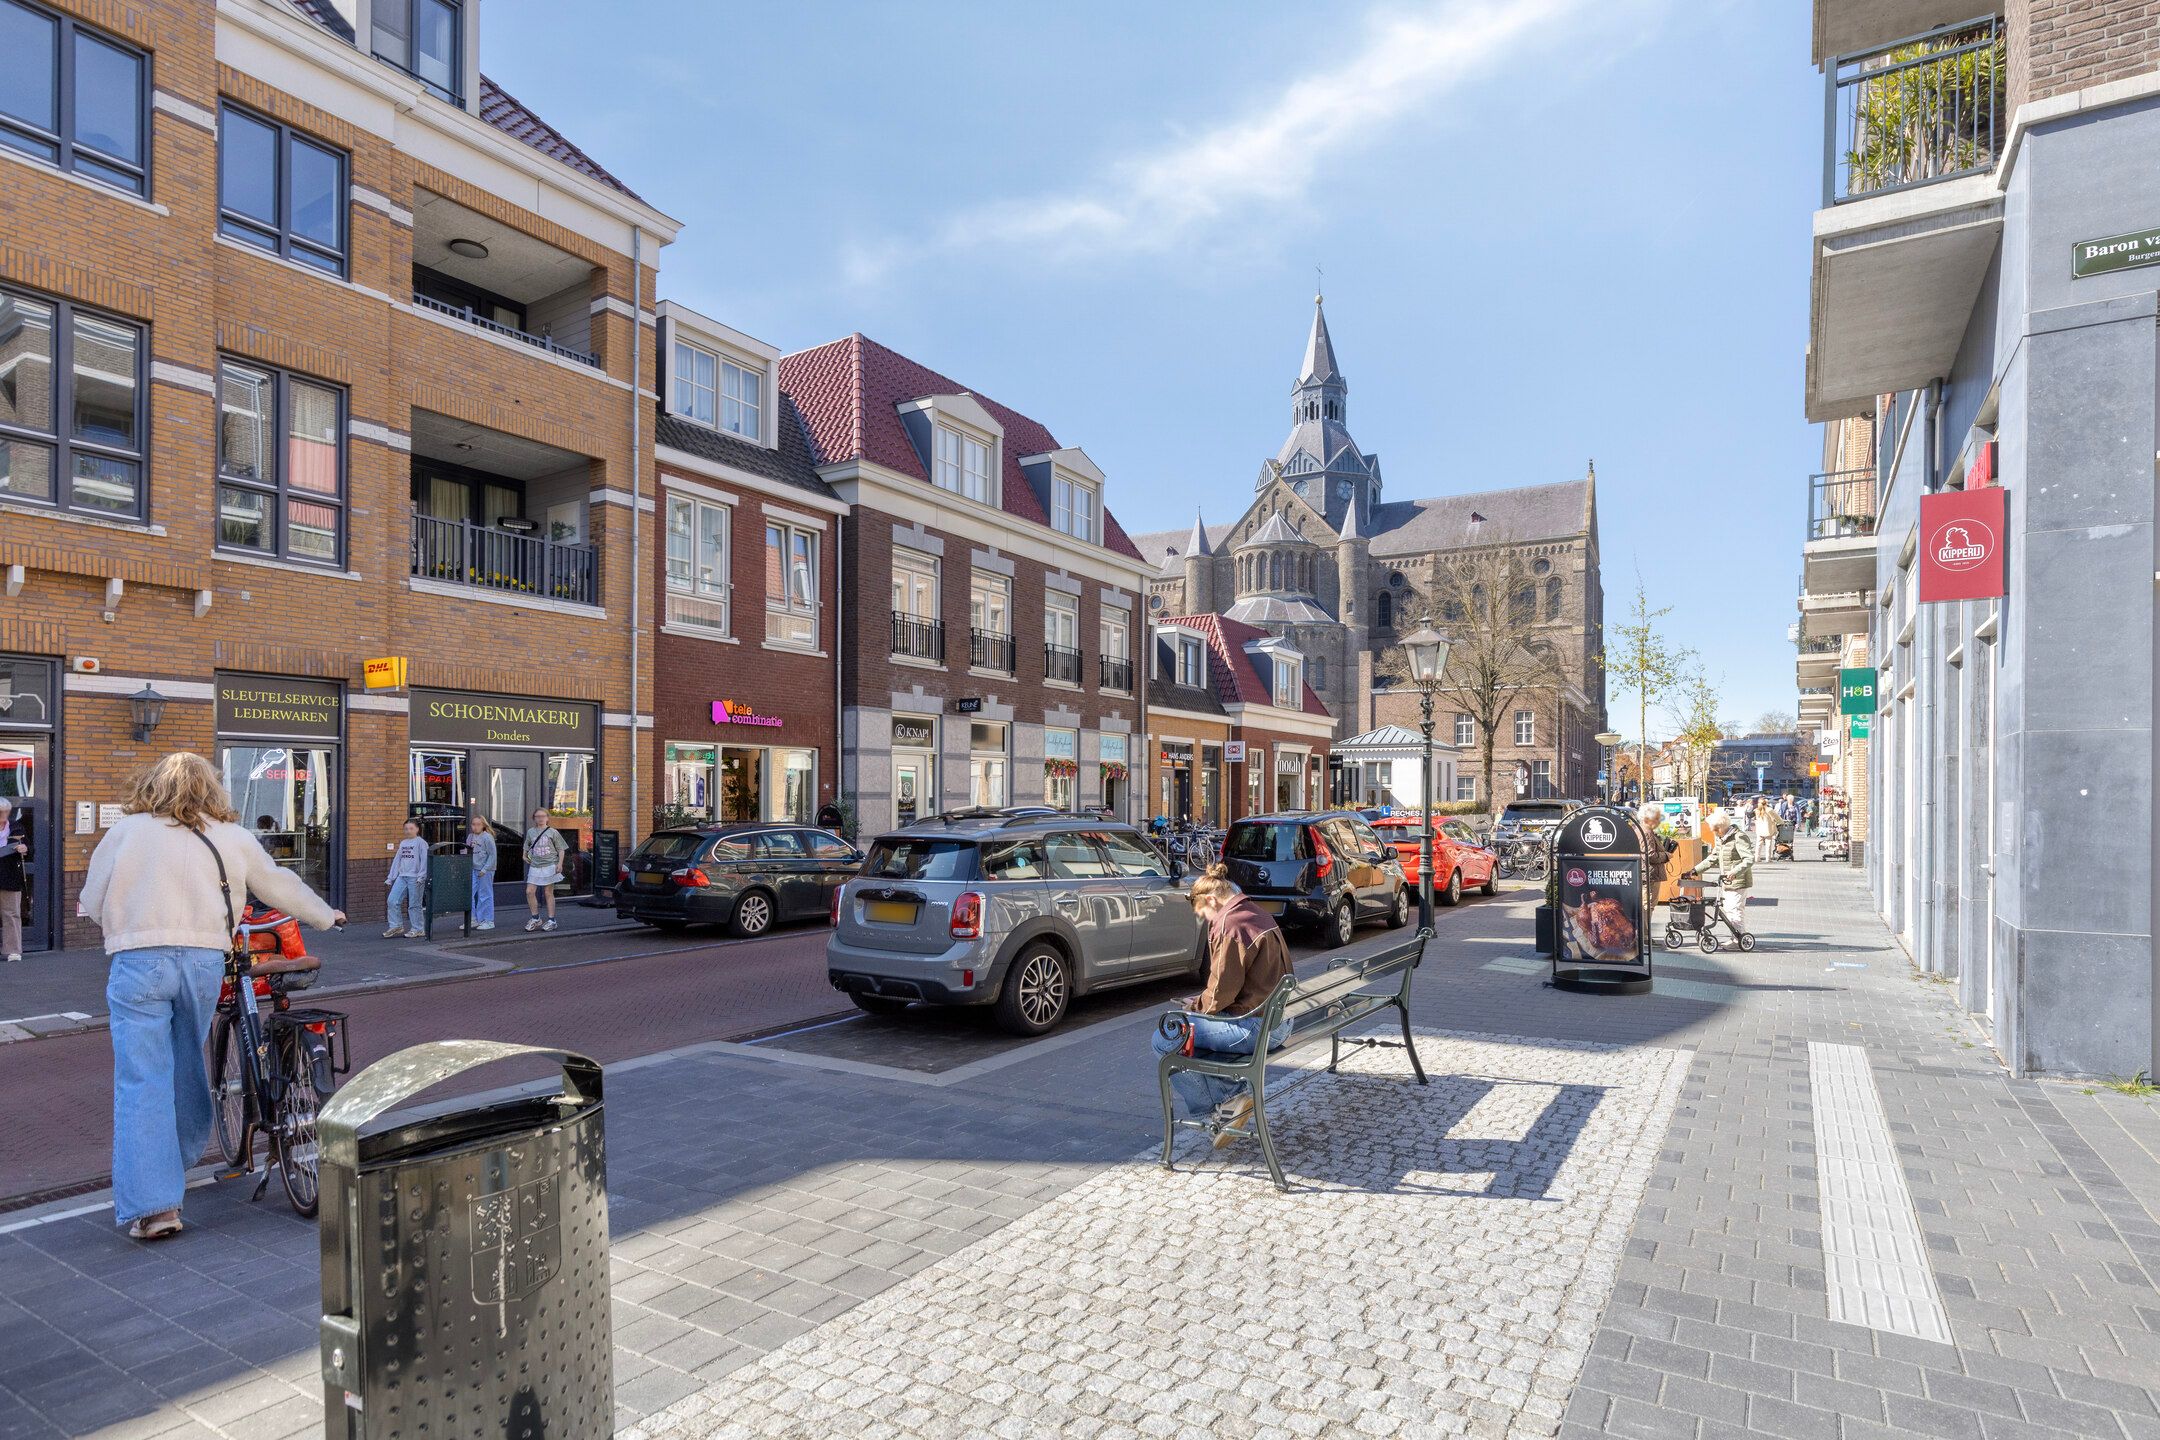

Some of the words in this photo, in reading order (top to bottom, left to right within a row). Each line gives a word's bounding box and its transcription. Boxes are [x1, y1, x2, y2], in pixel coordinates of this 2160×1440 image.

[2085, 240, 2139, 259] Baron
[1942, 547, 1981, 559] KIPPERIJ
[368, 663, 389, 673] DHL
[222, 689, 339, 707] SLEUTELSERVICE
[1843, 685, 1873, 698] H&B
[234, 708, 329, 722] LEDERWAREN
[430, 702, 580, 729] SCHOENMAKERIJ
[734, 704, 753, 715] tele
[732, 714, 783, 727] combinatie
[487, 730, 531, 742] Donders
[1279, 757, 1301, 773] noah
[1586, 834, 1612, 842] KIPPERIJ
[1587, 870, 1592, 878] 2
[1610, 871, 1632, 879] KIPPEN
